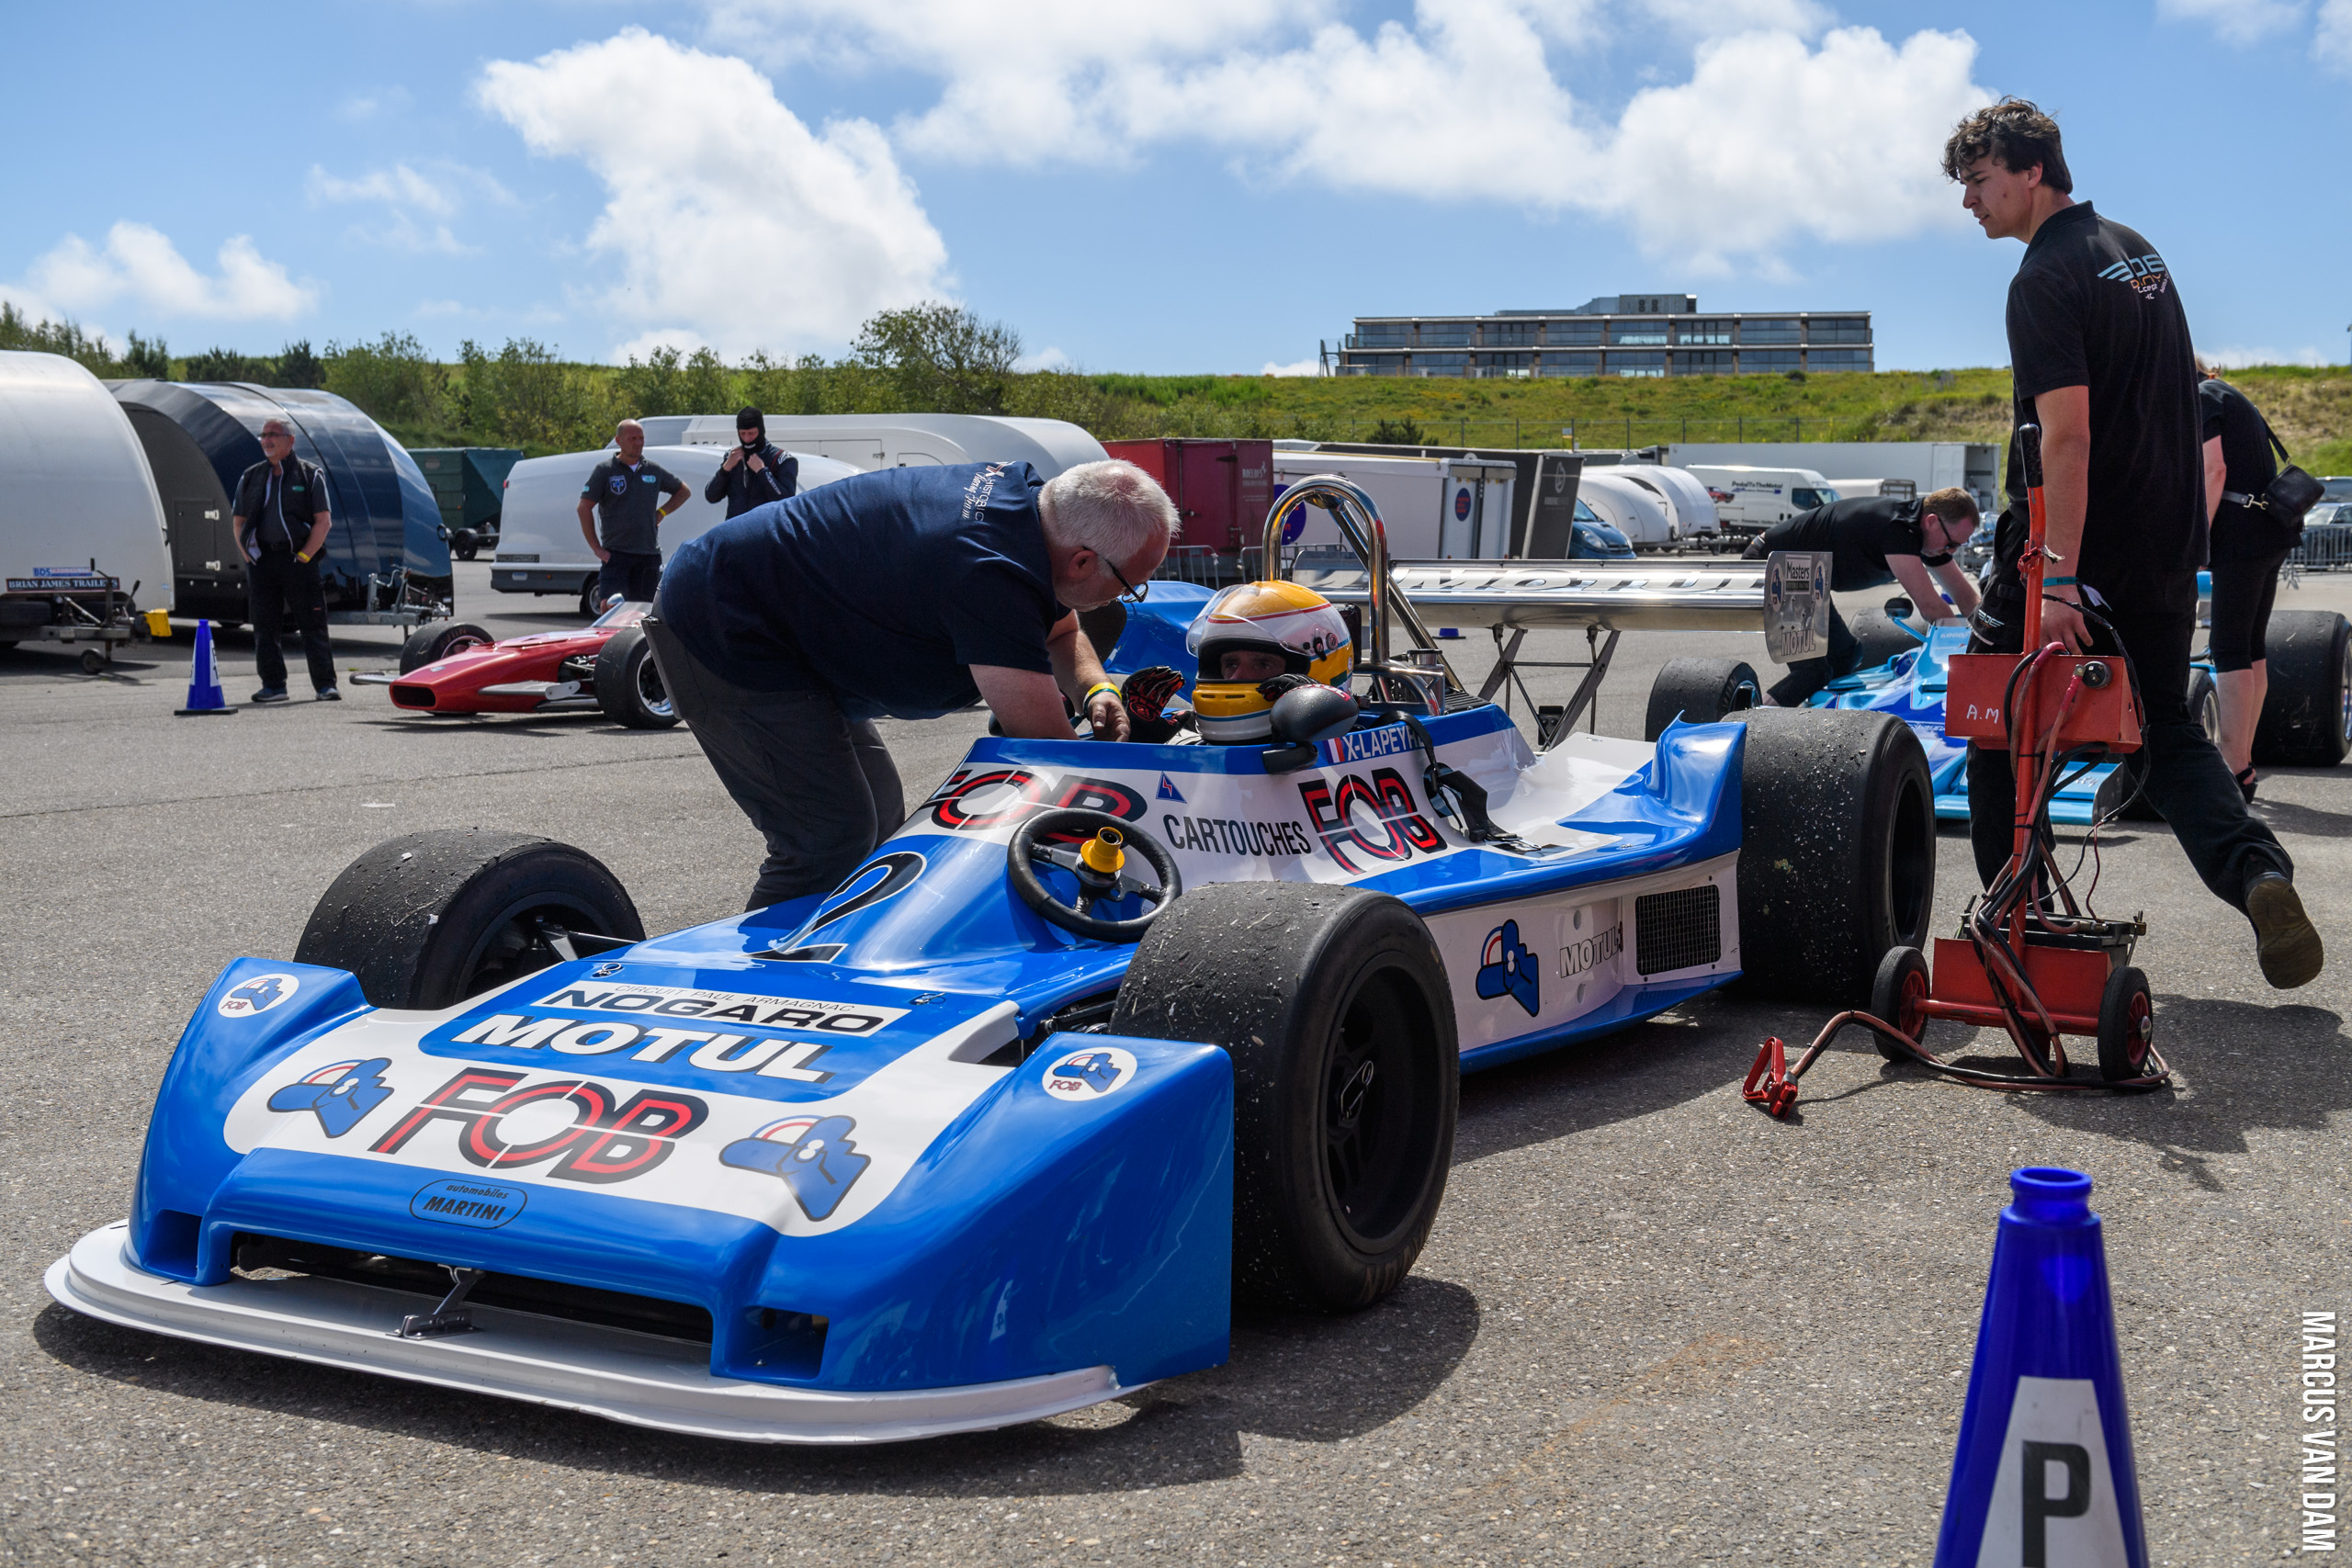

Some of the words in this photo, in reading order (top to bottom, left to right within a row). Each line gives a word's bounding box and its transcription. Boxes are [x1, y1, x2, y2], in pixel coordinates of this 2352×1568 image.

[975, 479, 996, 522] HISTORIC
[34, 568, 51, 577] BDS
[73, 580, 118, 588] TRAILES
[1786, 561, 1810, 580] Masters
[1781, 629, 1816, 657] MOTUL
[1966, 704, 1999, 724] A.M
[1297, 767, 1448, 875] FOB
[1163, 814, 1312, 856] CARTOUCHES
[1560, 925, 1622, 978] MOTUL
[221, 1000, 248, 1010] FOB
[542, 989, 885, 1032] NOGARO
[615, 985, 686, 998] CIRCUIT
[693, 990, 736, 1002] PAUL
[742, 996, 855, 1012] ARMAGNAC
[451, 1014, 837, 1084] MOTUL
[1048, 1079, 1082, 1091] FOB
[367, 1066, 709, 1185] FOB
[446, 1183, 510, 1200] automobiles
[423, 1196, 507, 1221] MARTINI
[2022, 1439, 2091, 1567] P
